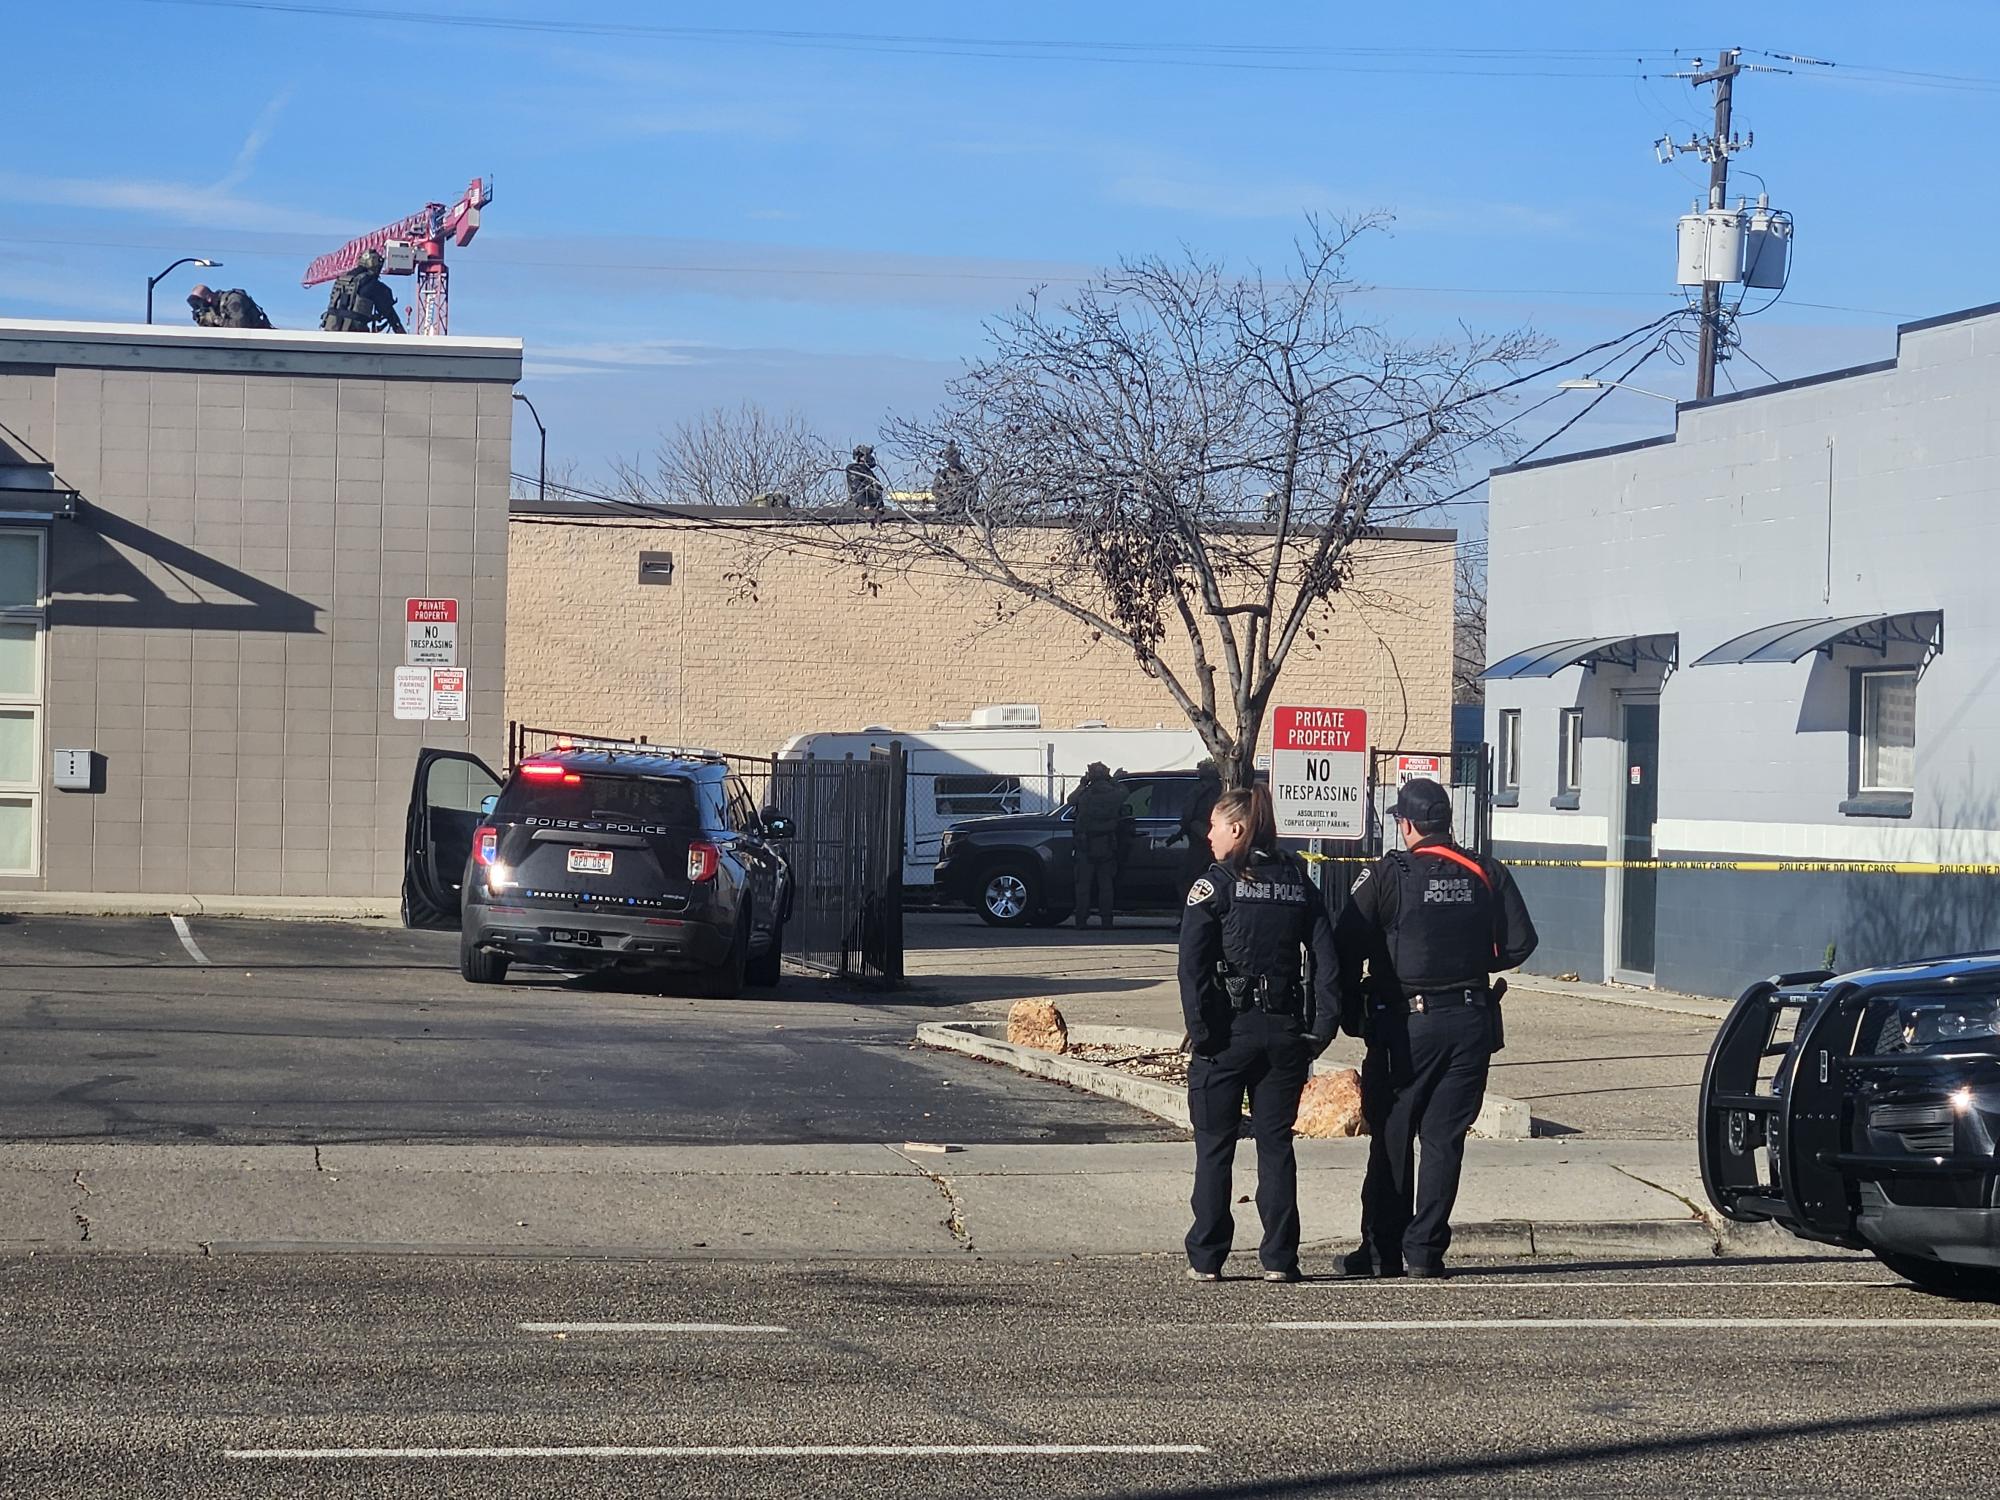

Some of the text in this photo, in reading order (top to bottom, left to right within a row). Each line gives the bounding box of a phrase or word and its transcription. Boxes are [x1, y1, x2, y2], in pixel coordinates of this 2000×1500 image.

[418, 601, 446, 610] PRIVATE
[415, 611, 449, 620] PROPERTY
[425, 626, 438, 638] NO
[410, 640, 453, 648] TRESPASSING
[1296, 711, 1345, 728] PRIVATE
[1289, 729, 1351, 747] PROPERTY
[1306, 758, 1330, 782] NO
[1400, 772, 1413, 784] NO
[1279, 785, 1358, 802] TRESPASSING
[1297, 810, 1330, 818] ABSOLUTELY
[525, 817, 579, 829] BOISE
[606, 823, 667, 835] POLICE
[1284, 818, 1350, 829] CORPUS CHRISTI PARKING
[1709, 862, 1738, 870] CROSS
[1778, 863, 1897, 872] POLICE LINE DO NOT CROSS
[1939, 865, 1970, 873] POLICE
[1972, 865, 1991, 874] LINE
[1429, 878, 1469, 891] BOISE
[534, 891, 580, 899] PROTECT
[591, 895, 624, 903] SERVE
[1236, 881, 1307, 902] BOISE POLICE
[1423, 889, 1472, 902] POLICE
